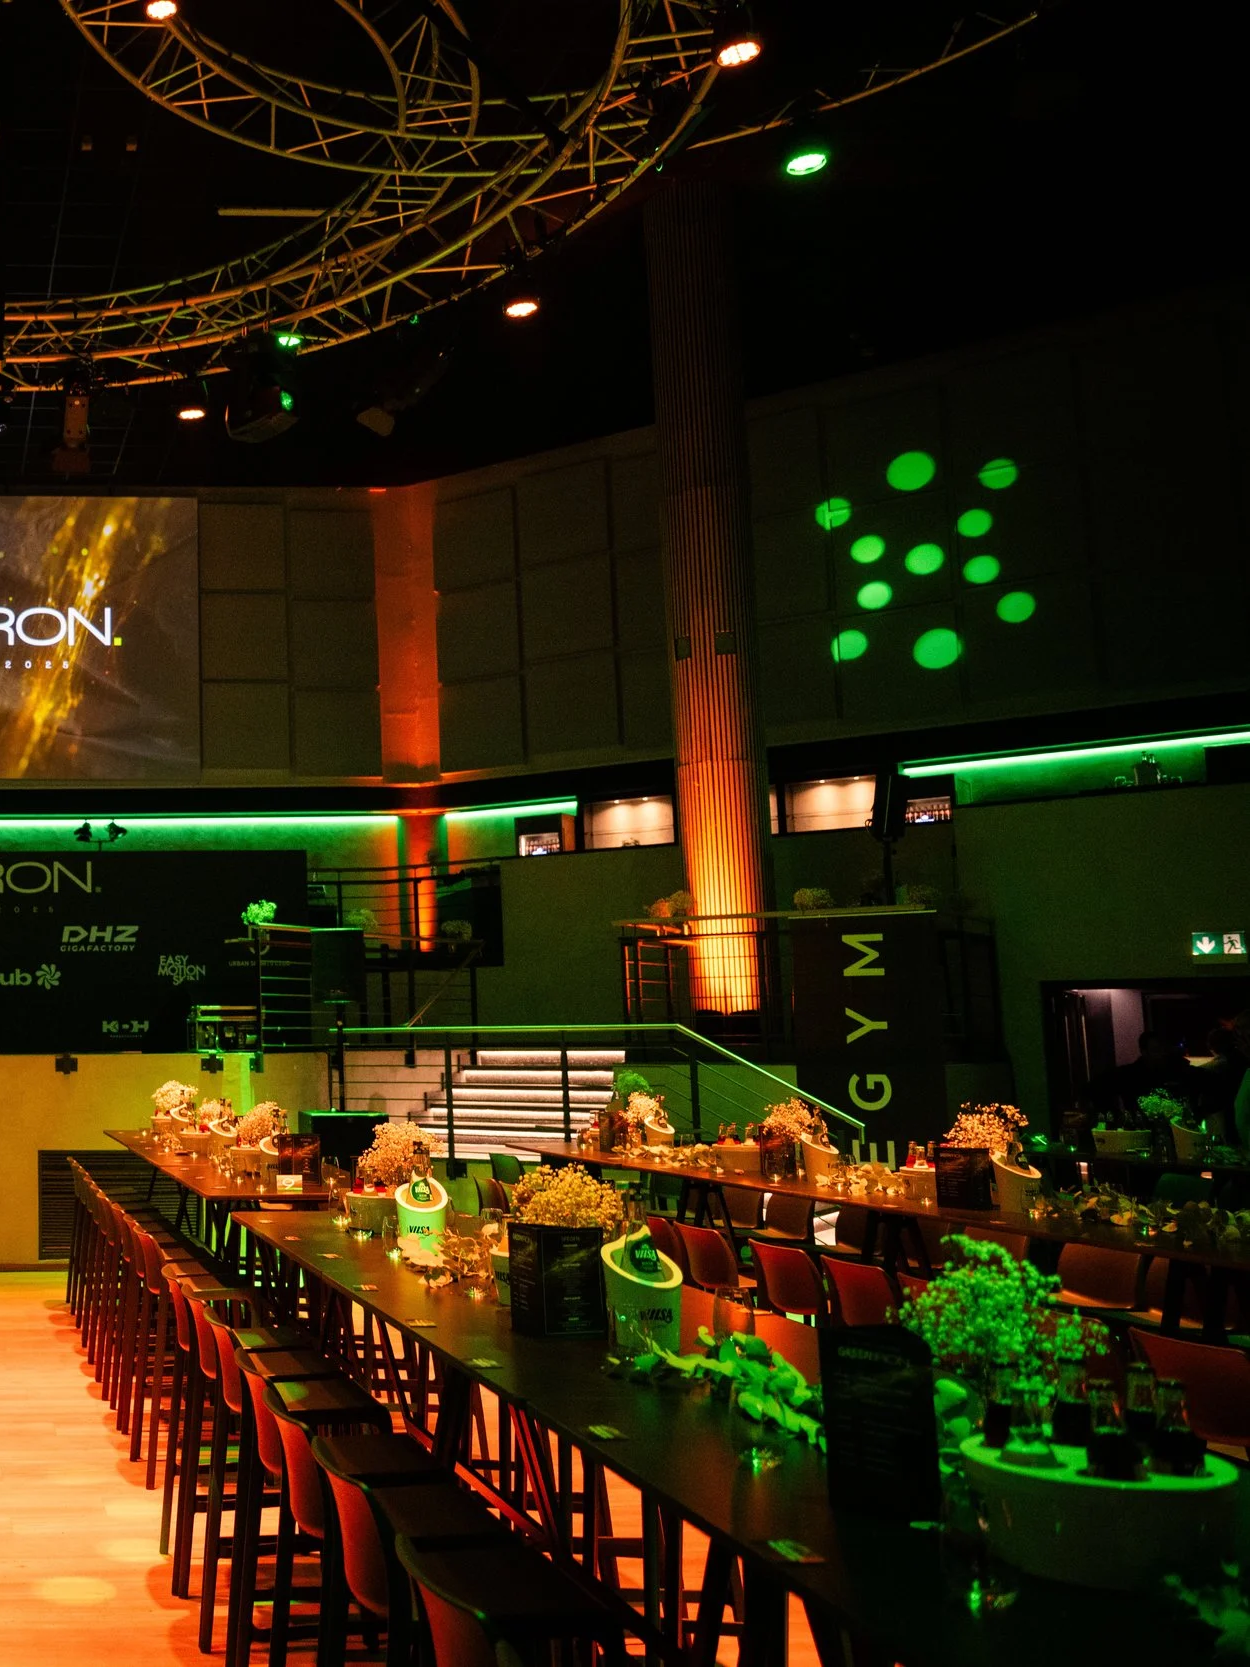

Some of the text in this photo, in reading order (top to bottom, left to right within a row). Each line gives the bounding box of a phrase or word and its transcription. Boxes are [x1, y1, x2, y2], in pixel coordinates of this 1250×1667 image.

[4, 660, 69, 669] 2025
[61, 925, 140, 943] DHZ
[59, 944, 136, 952] GIGAFACTORY
[159, 955, 189, 966] EASY
[158, 964, 206, 977] MOTION
[841, 932, 896, 1172] EGYM
